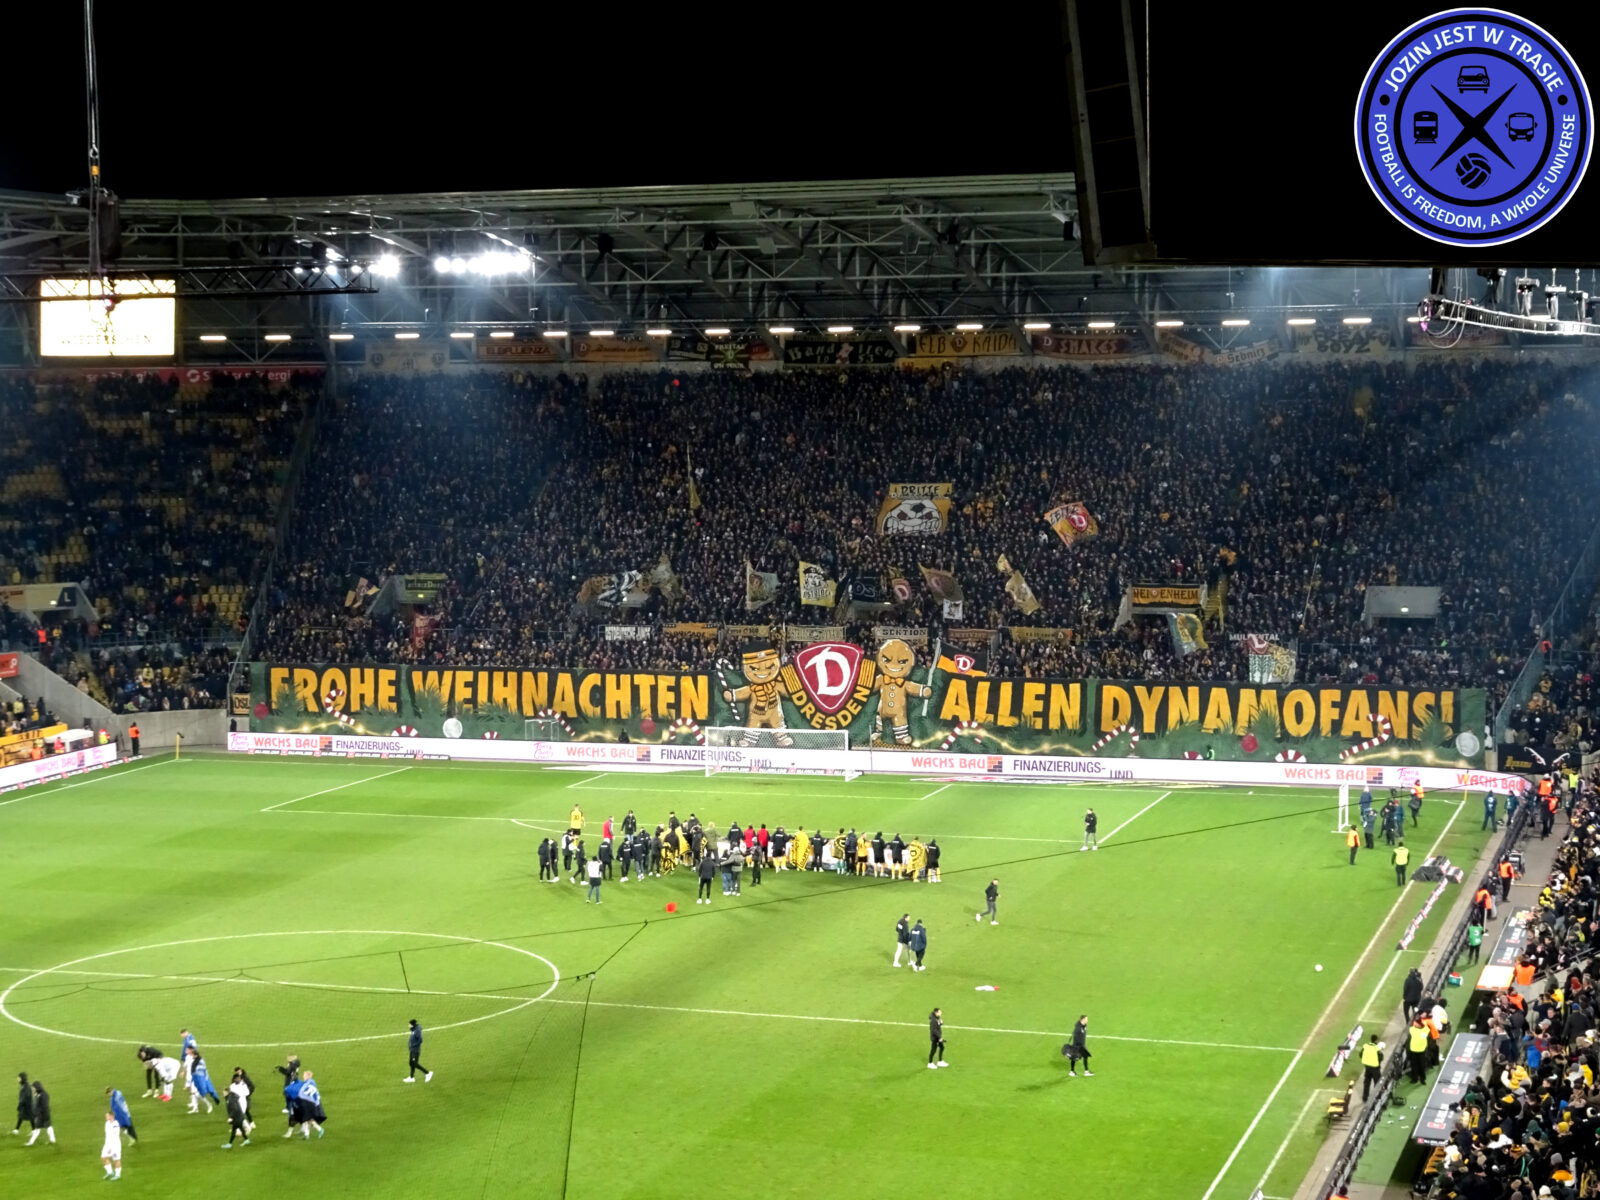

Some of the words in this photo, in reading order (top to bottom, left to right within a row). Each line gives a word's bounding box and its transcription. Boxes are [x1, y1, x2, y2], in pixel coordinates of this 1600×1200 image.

[270, 667, 397, 713] FROHE
[411, 669, 709, 720] WEIHNACHTEN
[940, 678, 1081, 730] ALLEN
[1101, 684, 1454, 739] DYNAMOFANS!
[791, 686, 871, 730] DRESDEN
[254, 736, 291, 748] WACHS
[295, 738, 318, 749] BAU
[336, 740, 404, 751] FINANZIERUNGS-
[566, 746, 606, 758] WACHS
[610, 748, 635, 758] BAU
[660, 748, 747, 762] FINANZIERUNGS-
[911, 756, 954, 769] WACHS
[959, 757, 986, 769] BAU
[1013, 760, 1106, 773] FINANZIERUNGS-
[1284, 767, 1331, 779] WACHS
[1336, 769, 1364, 781] BAU
[1457, 774, 1498, 788] WACHS
[1501, 777, 1526, 792] BAU
